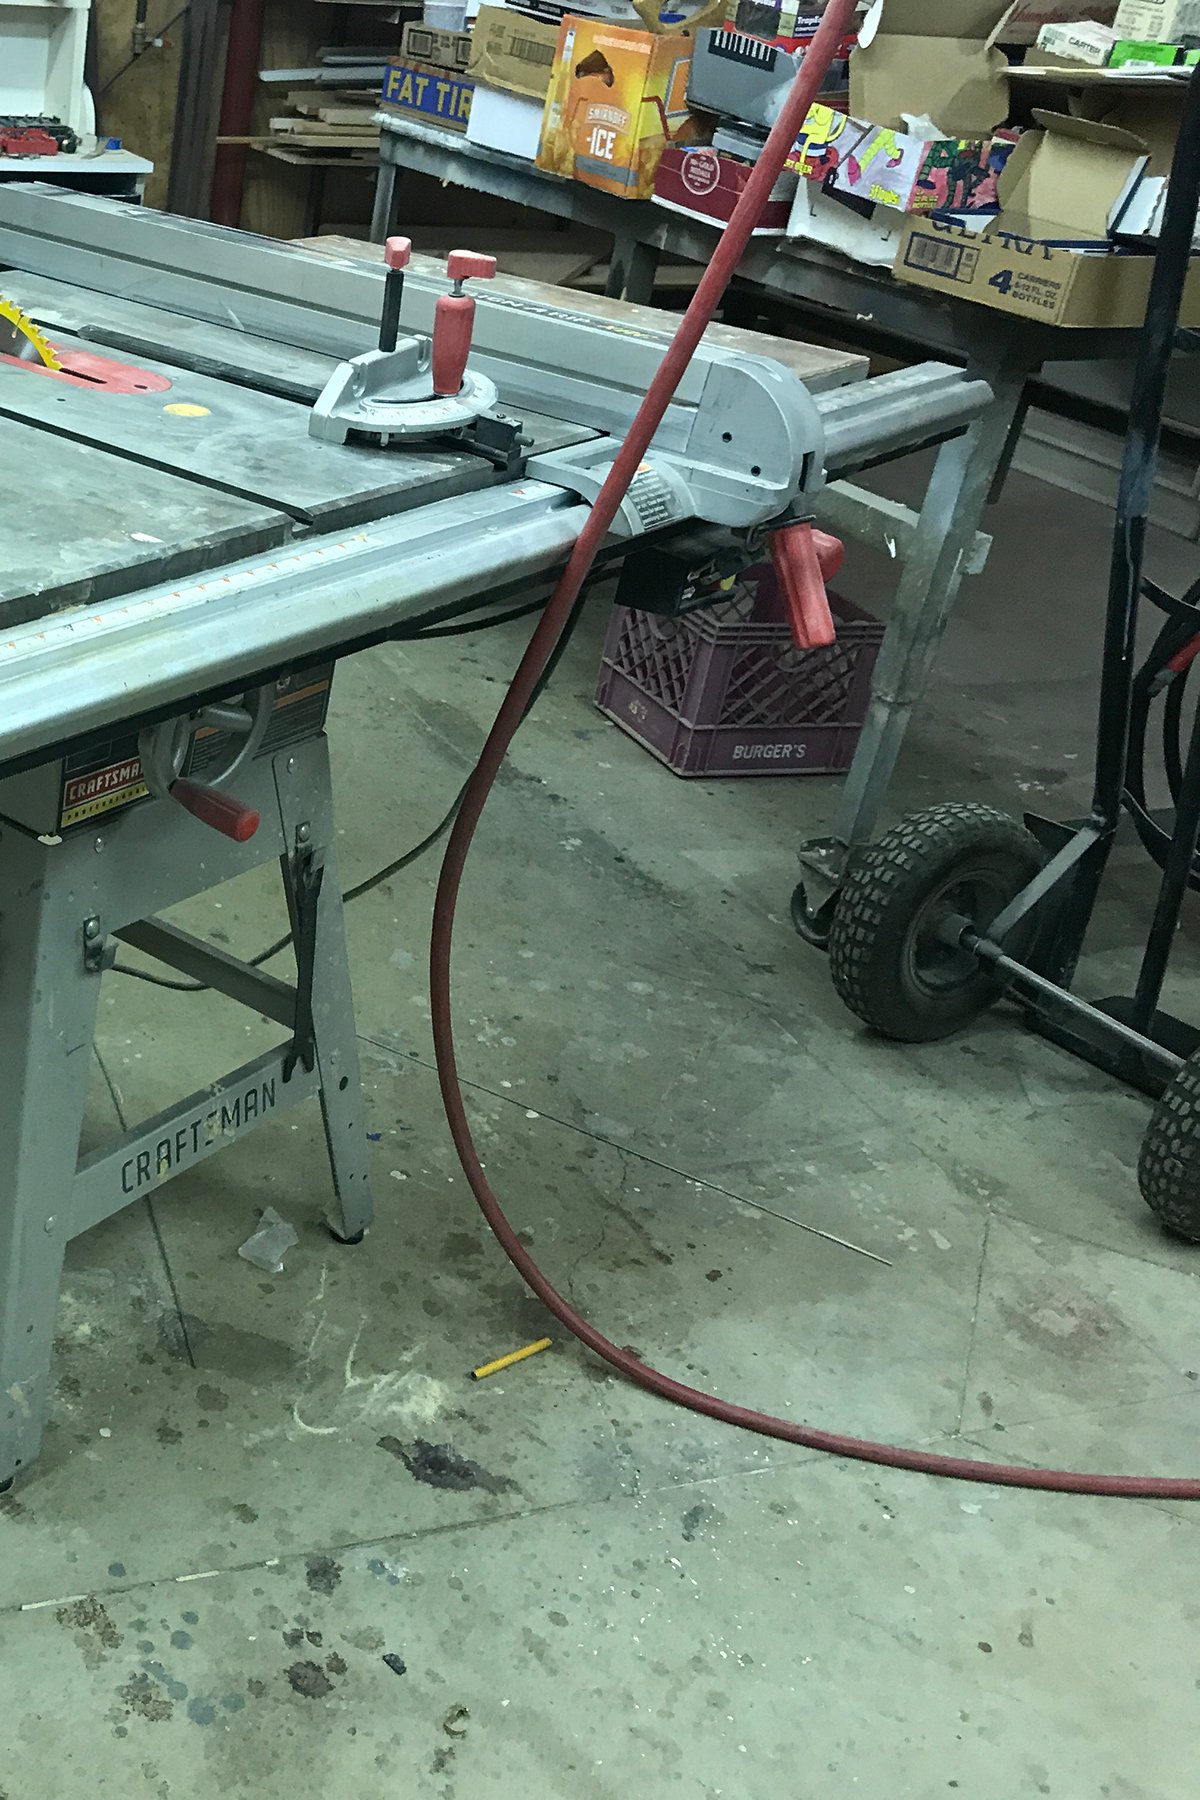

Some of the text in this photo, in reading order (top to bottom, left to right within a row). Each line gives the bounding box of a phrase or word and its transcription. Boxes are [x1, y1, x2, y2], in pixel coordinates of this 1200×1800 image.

[386, 70, 475, 120] FAT TIR
[587, 127, 616, 160] ICE
[988, 269, 1014, 295] 4
[1012, 290, 1056, 309] BOTTLES
[732, 743, 807, 760] BURGER'S
[69, 762, 144, 801] CRAFTSMA
